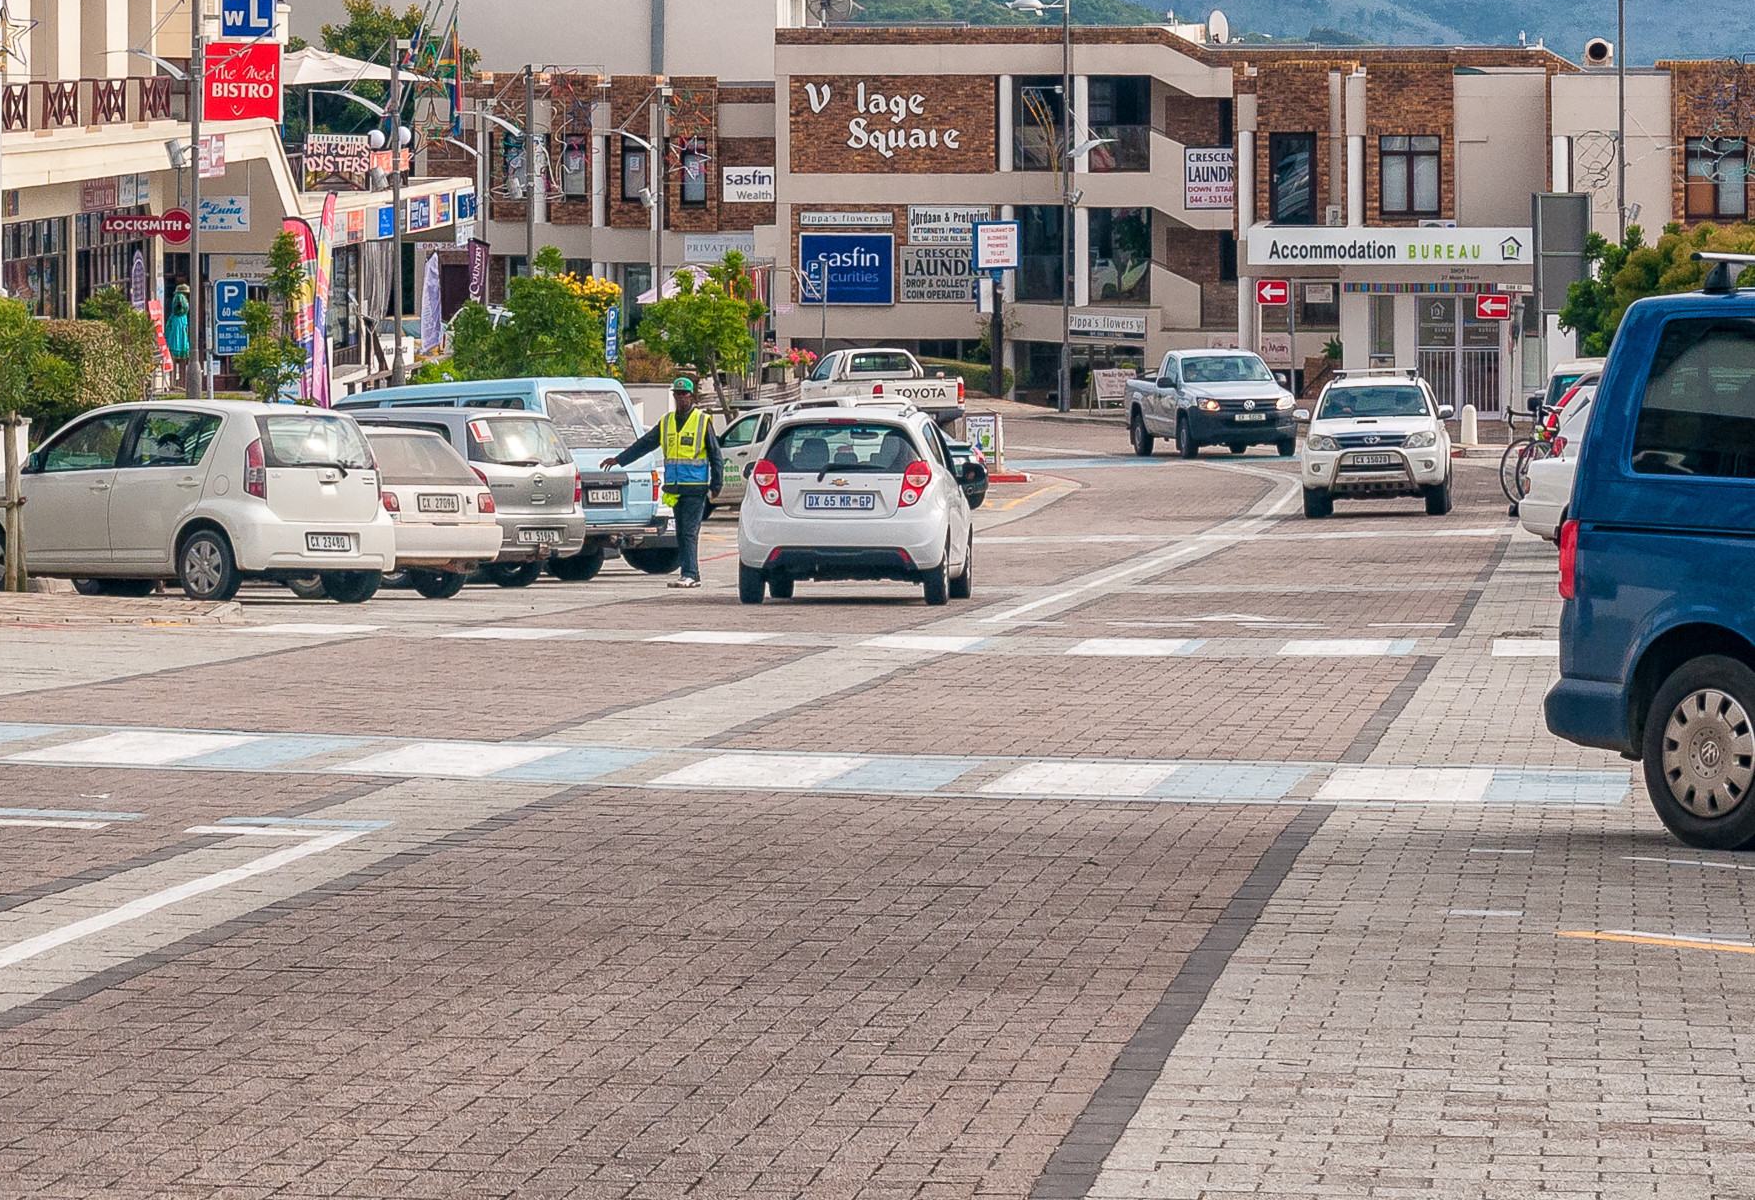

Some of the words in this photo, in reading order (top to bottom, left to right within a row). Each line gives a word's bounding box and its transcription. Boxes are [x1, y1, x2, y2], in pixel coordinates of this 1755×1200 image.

[210, 63, 238, 81] The
[211, 82, 274, 98] BISTRO
[307, 142, 329, 155] FISH
[337, 143, 371, 157] CHIPS
[307, 155, 370, 173] OYSTERS
[725, 169, 772, 185] sasfin
[736, 190, 772, 200] Wealth
[207, 203, 243, 216] Luna
[911, 209, 941, 226] Jordaan
[106, 220, 182, 231] LOCKSMITH
[818, 246, 879, 267] sasfin
[1269, 240, 1396, 260] Accommodation
[1408, 244, 1481, 259] BUREAU
[469, 245, 482, 295] COUNTRY
[904, 259, 986, 276] LAUNDR
[828, 271, 879, 283] curities
[906, 280, 926, 288] DROP
[935, 280, 969, 288] COLLECT
[224, 286, 239, 304] P
[906, 290, 925, 299] COIN
[926, 290, 966, 299] OPERATED
[895, 388, 946, 398] TOYOTA
[808, 495, 820, 506] DX
[823, 495, 835, 506] 65
[839, 495, 851, 506] MR
[859, 495, 871, 506] GP
[310, 536, 320, 547] CX
